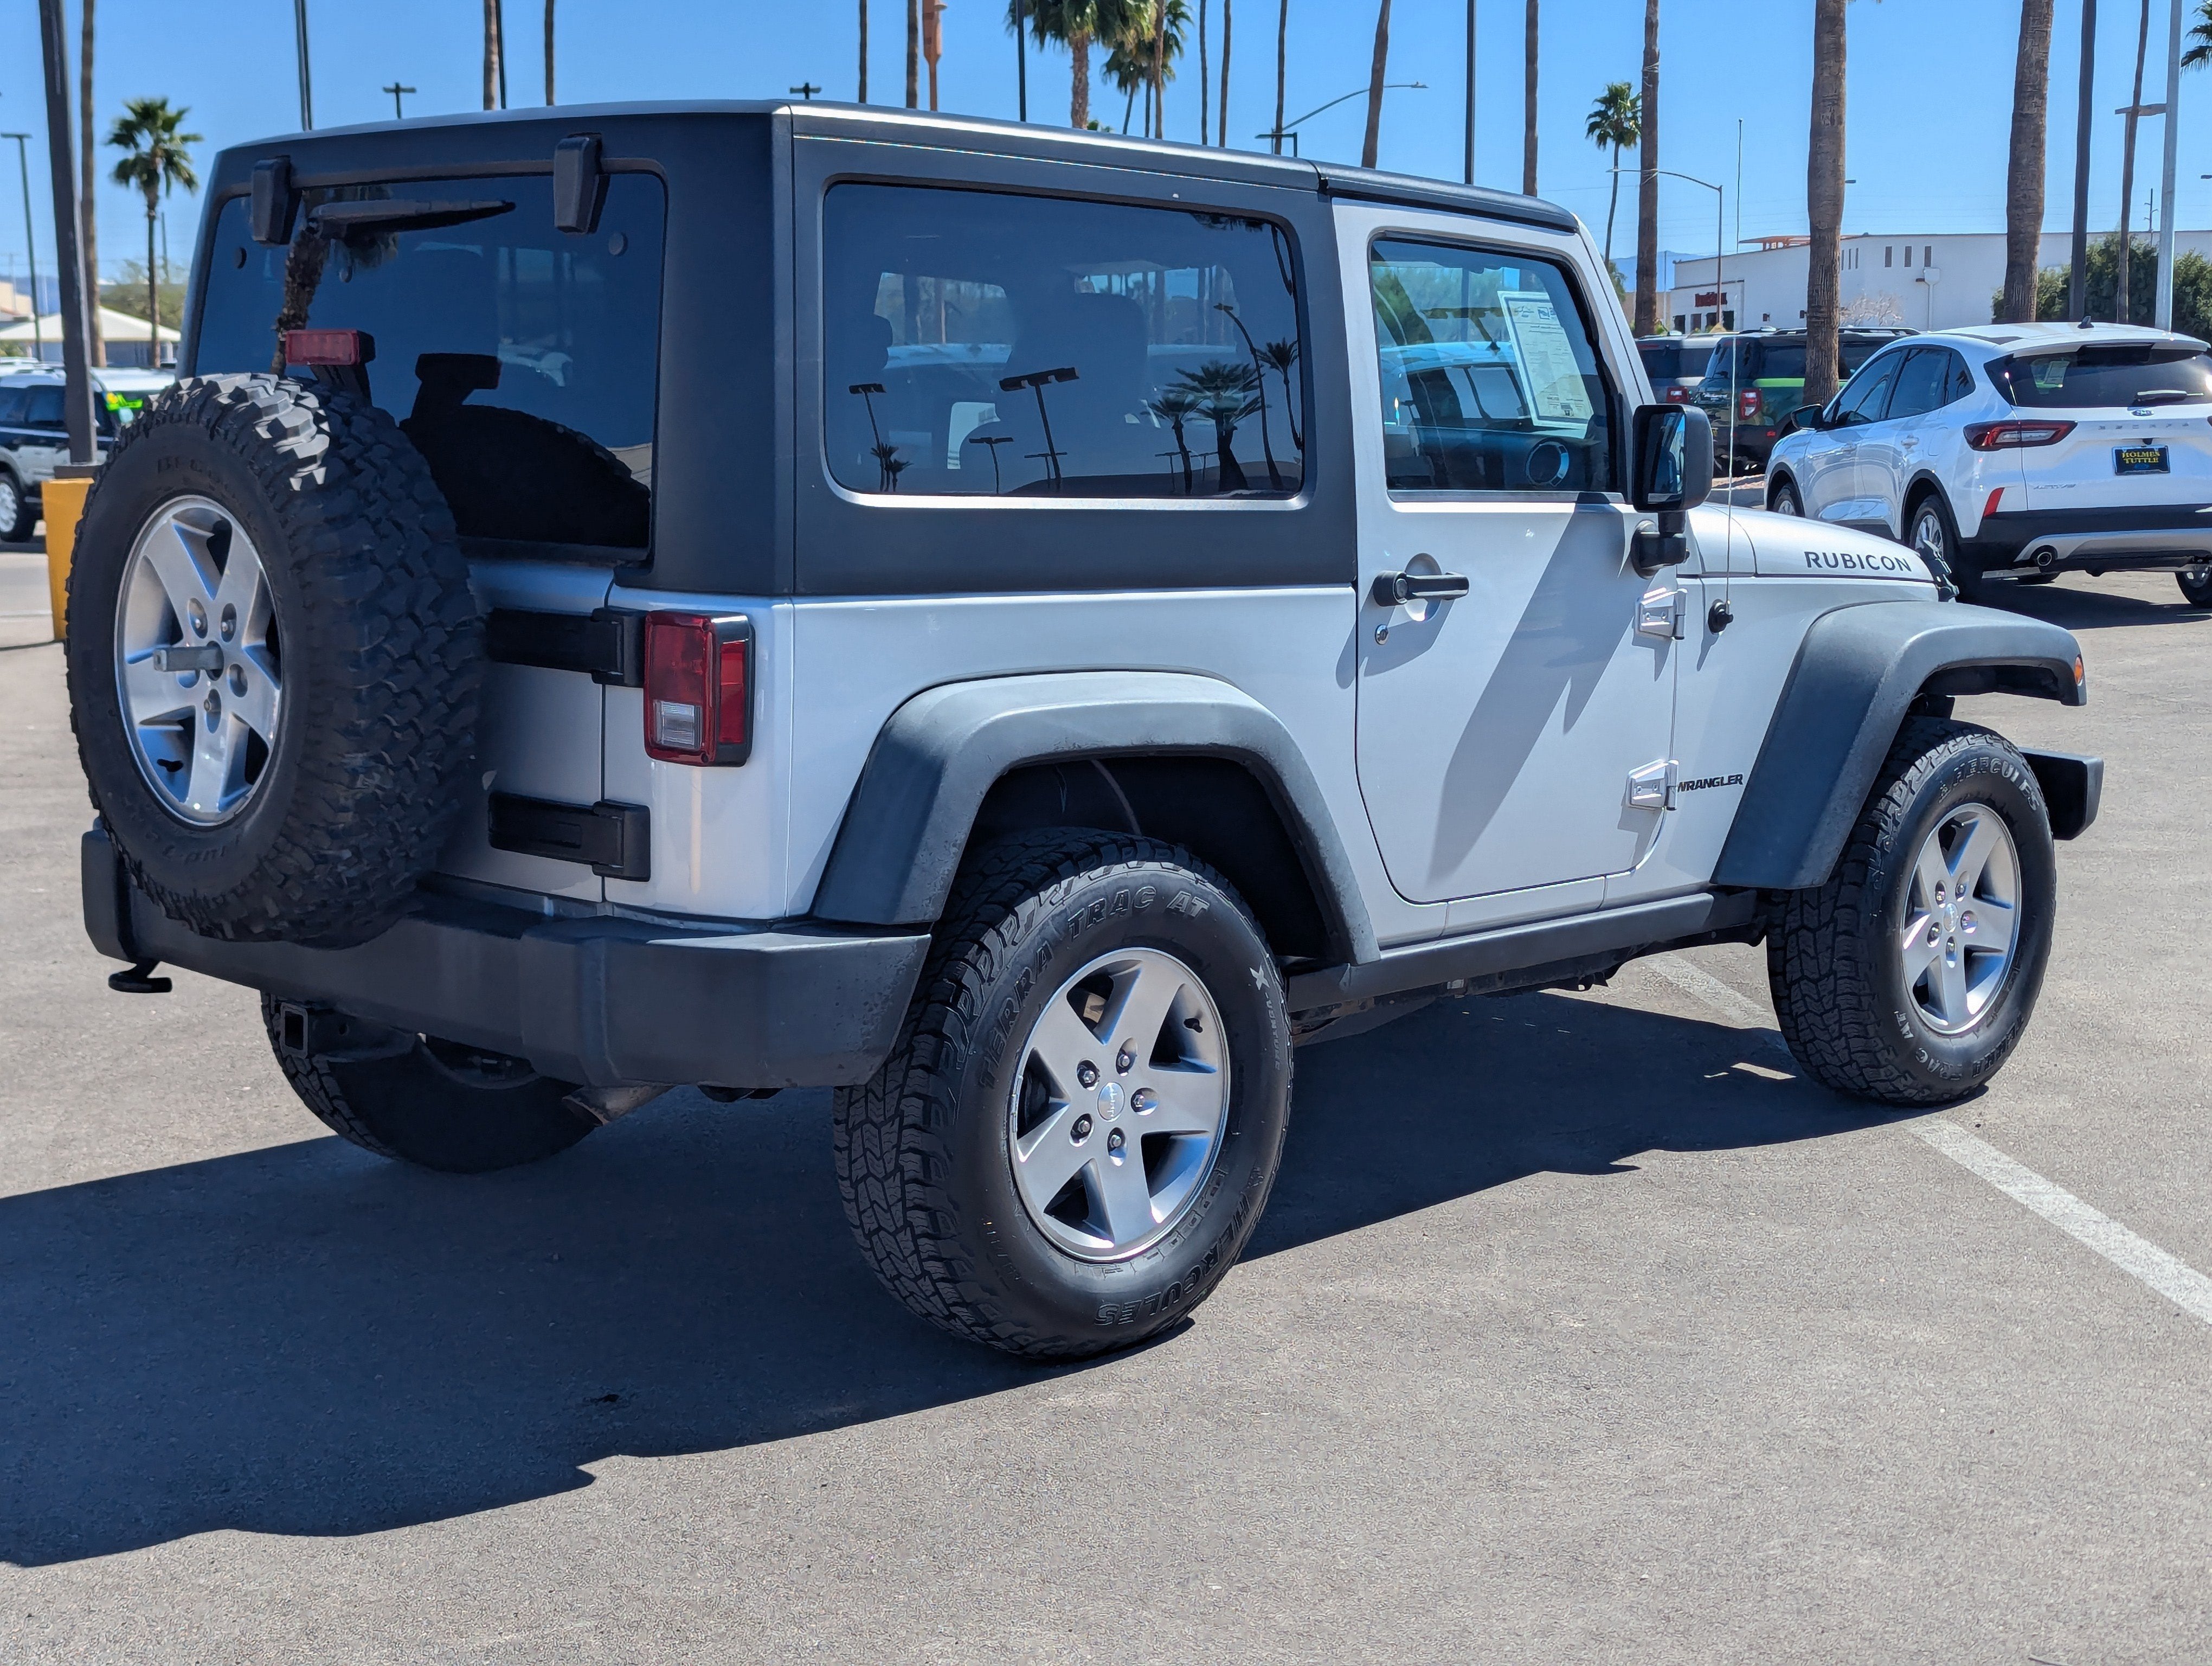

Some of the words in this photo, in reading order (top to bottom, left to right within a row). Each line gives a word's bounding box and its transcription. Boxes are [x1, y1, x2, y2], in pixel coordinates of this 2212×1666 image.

[1804, 551, 1912, 572] RUBICON
[1677, 774, 1743, 792] WRANGLER
[1068, 886, 1156, 940] TRAC
[1166, 890, 1210, 918] AT
[1094, 1191, 1250, 1325] HERCULES
